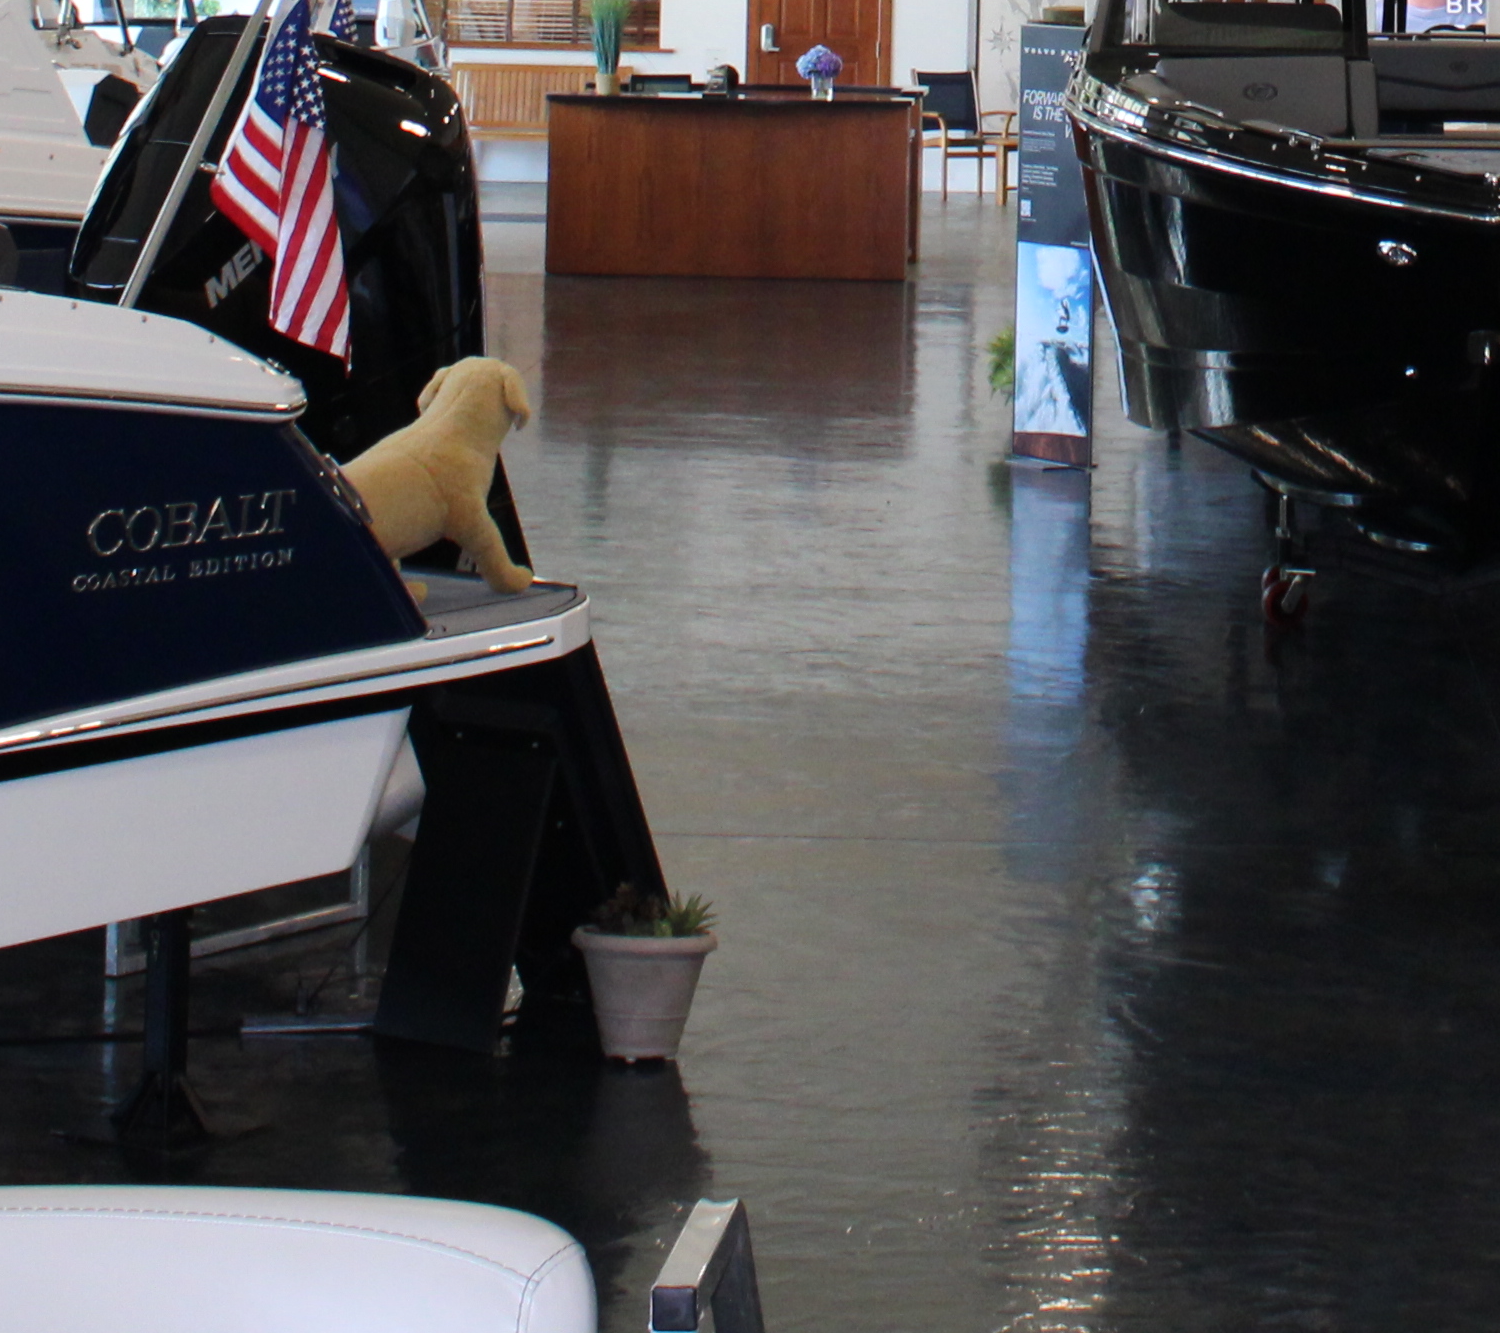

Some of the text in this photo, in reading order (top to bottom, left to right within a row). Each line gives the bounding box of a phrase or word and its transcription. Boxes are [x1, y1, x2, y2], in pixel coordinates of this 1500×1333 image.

[1023, 46, 1056, 56] VOLVO
[1022, 89, 1067, 106] FORWAR
[1033, 105, 1043, 121] IS
[1045, 106, 1065, 123] THE
[86, 489, 297, 558] COBALT
[71, 548, 295, 593] COASTAL EDITION
